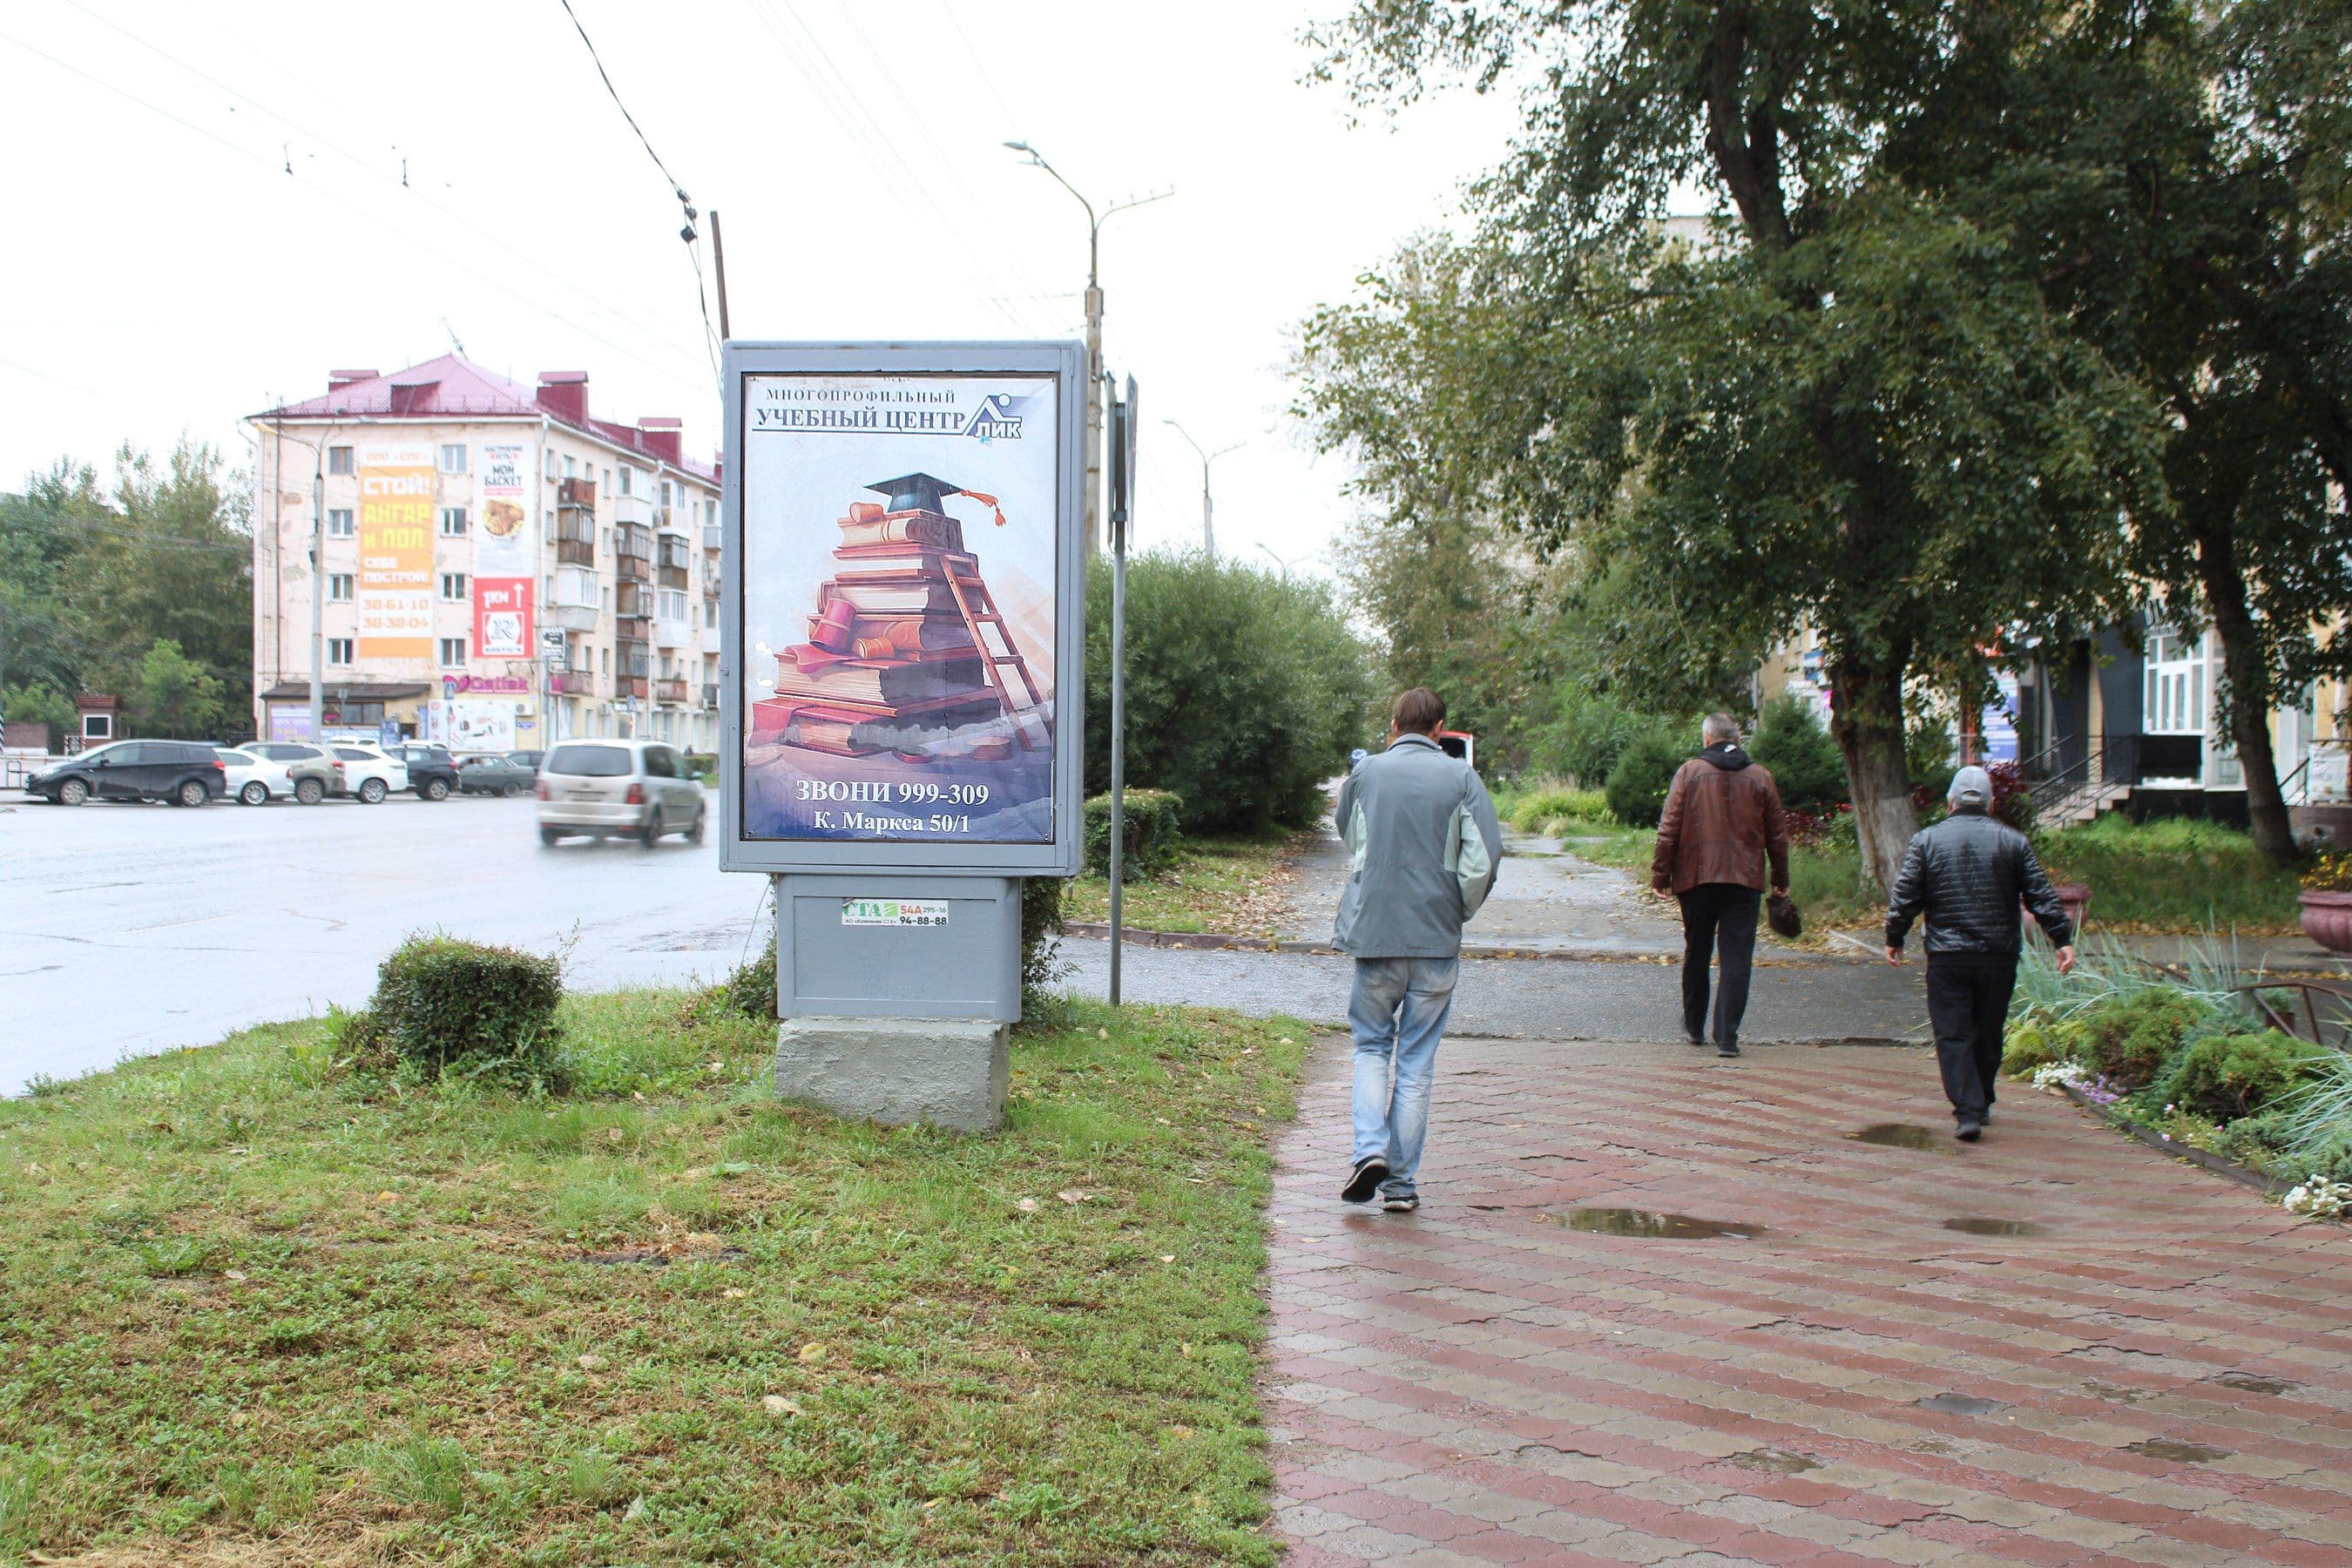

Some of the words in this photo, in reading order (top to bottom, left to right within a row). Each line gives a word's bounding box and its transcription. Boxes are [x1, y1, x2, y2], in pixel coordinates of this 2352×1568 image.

[766, 389, 955, 403] МНОГОПРОФИЛЬНЫЙ
[756, 406, 878, 428] УЧЕБНЫЙ
[885, 410, 966, 432] ЦЕНТР
[363, 473, 430, 496] СТОЙ!
[363, 503, 430, 524] АНГАР
[382, 528, 423, 550] ПОЛ
[794, 780, 892, 803] ЗВОНИ
[898, 782, 990, 806] 999-309
[814, 811, 835, 829] К.
[842, 811, 923, 835] Маркса
[929, 814, 970, 833] 50/1
[899, 916, 947, 925] 94-88-88
[900, 905, 923, 915] 54А
